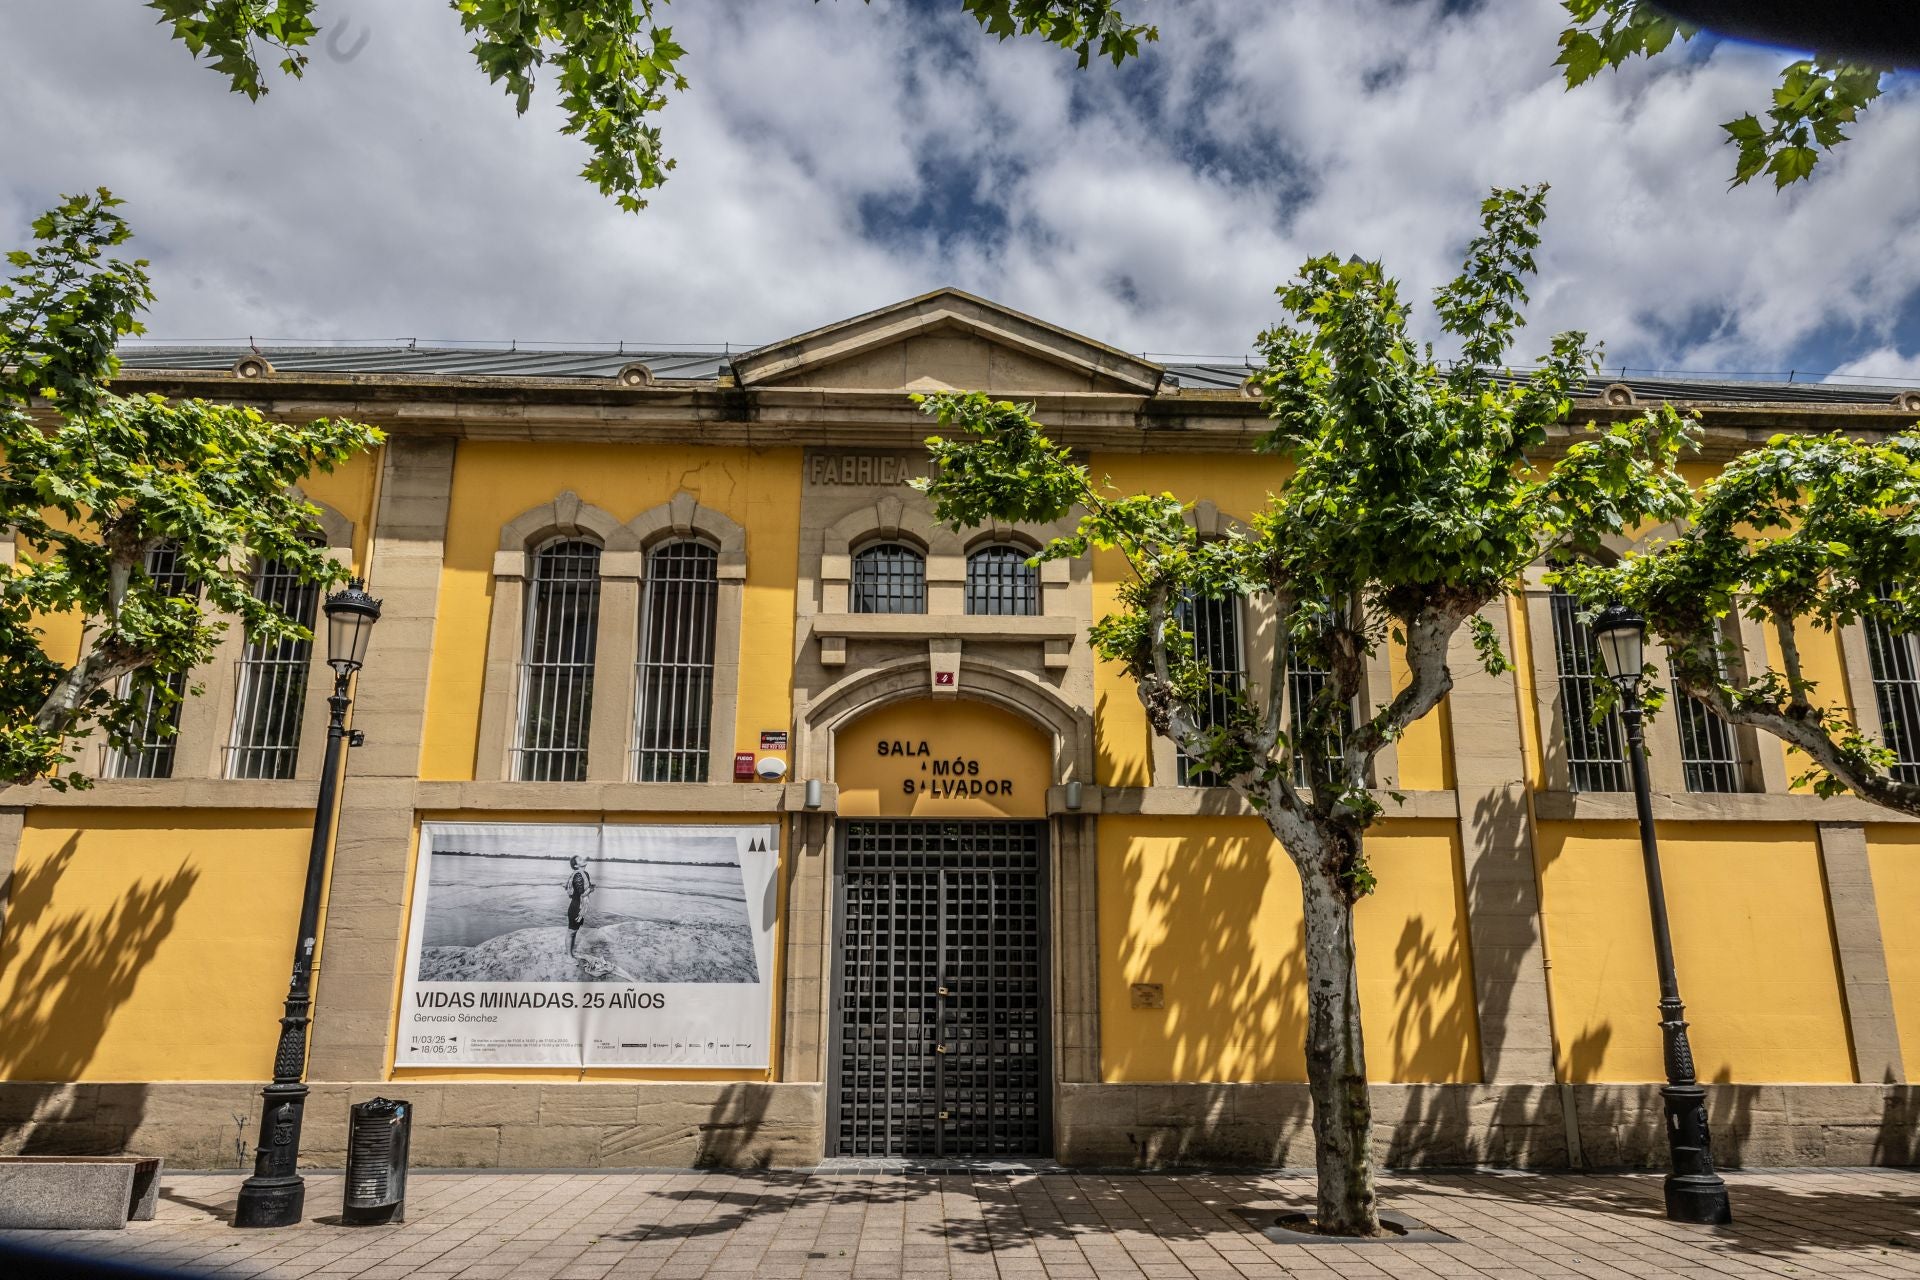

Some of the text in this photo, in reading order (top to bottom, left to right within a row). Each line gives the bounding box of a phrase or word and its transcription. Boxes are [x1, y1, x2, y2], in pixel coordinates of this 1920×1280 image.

[810, 455, 911, 486] FABRICA
[877, 741, 931, 756] SALA
[415, 988, 665, 1009] VIDAS MINADAS. 25 AÑOS
[413, 1013, 498, 1023] Gervasio Sánchez
[412, 1035, 446, 1044] 11/03/25
[421, 1045, 458, 1054] 18/05/25
